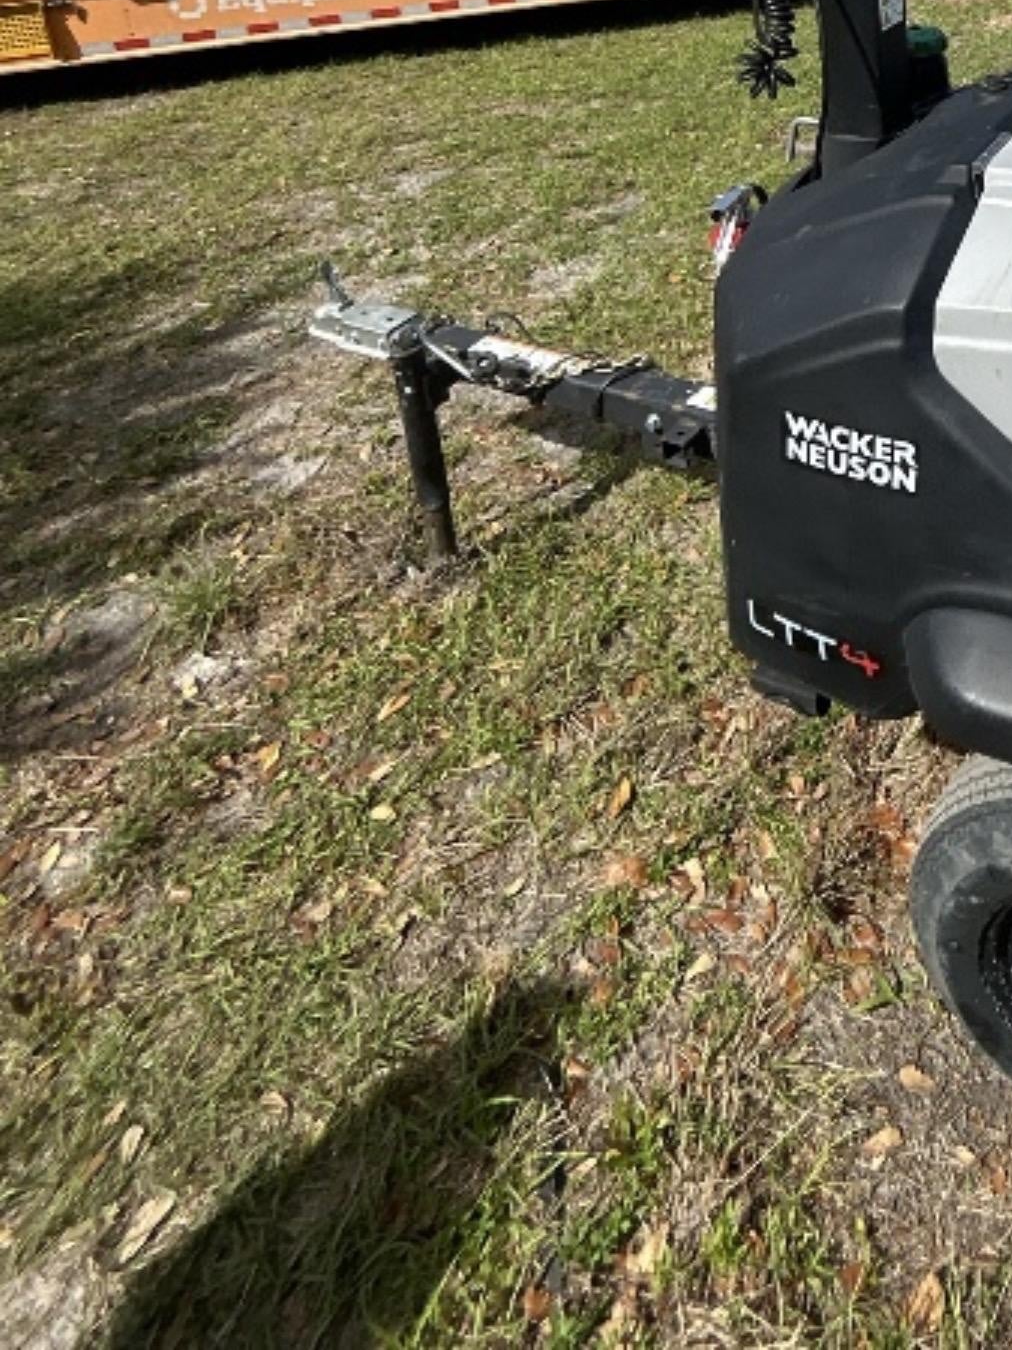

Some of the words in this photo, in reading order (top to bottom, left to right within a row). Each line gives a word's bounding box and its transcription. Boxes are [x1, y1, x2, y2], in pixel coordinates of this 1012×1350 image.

[784, 410, 919, 468] WACKER
[785, 436, 920, 493] NEUSON
[747, 599, 880, 678] LTT4
